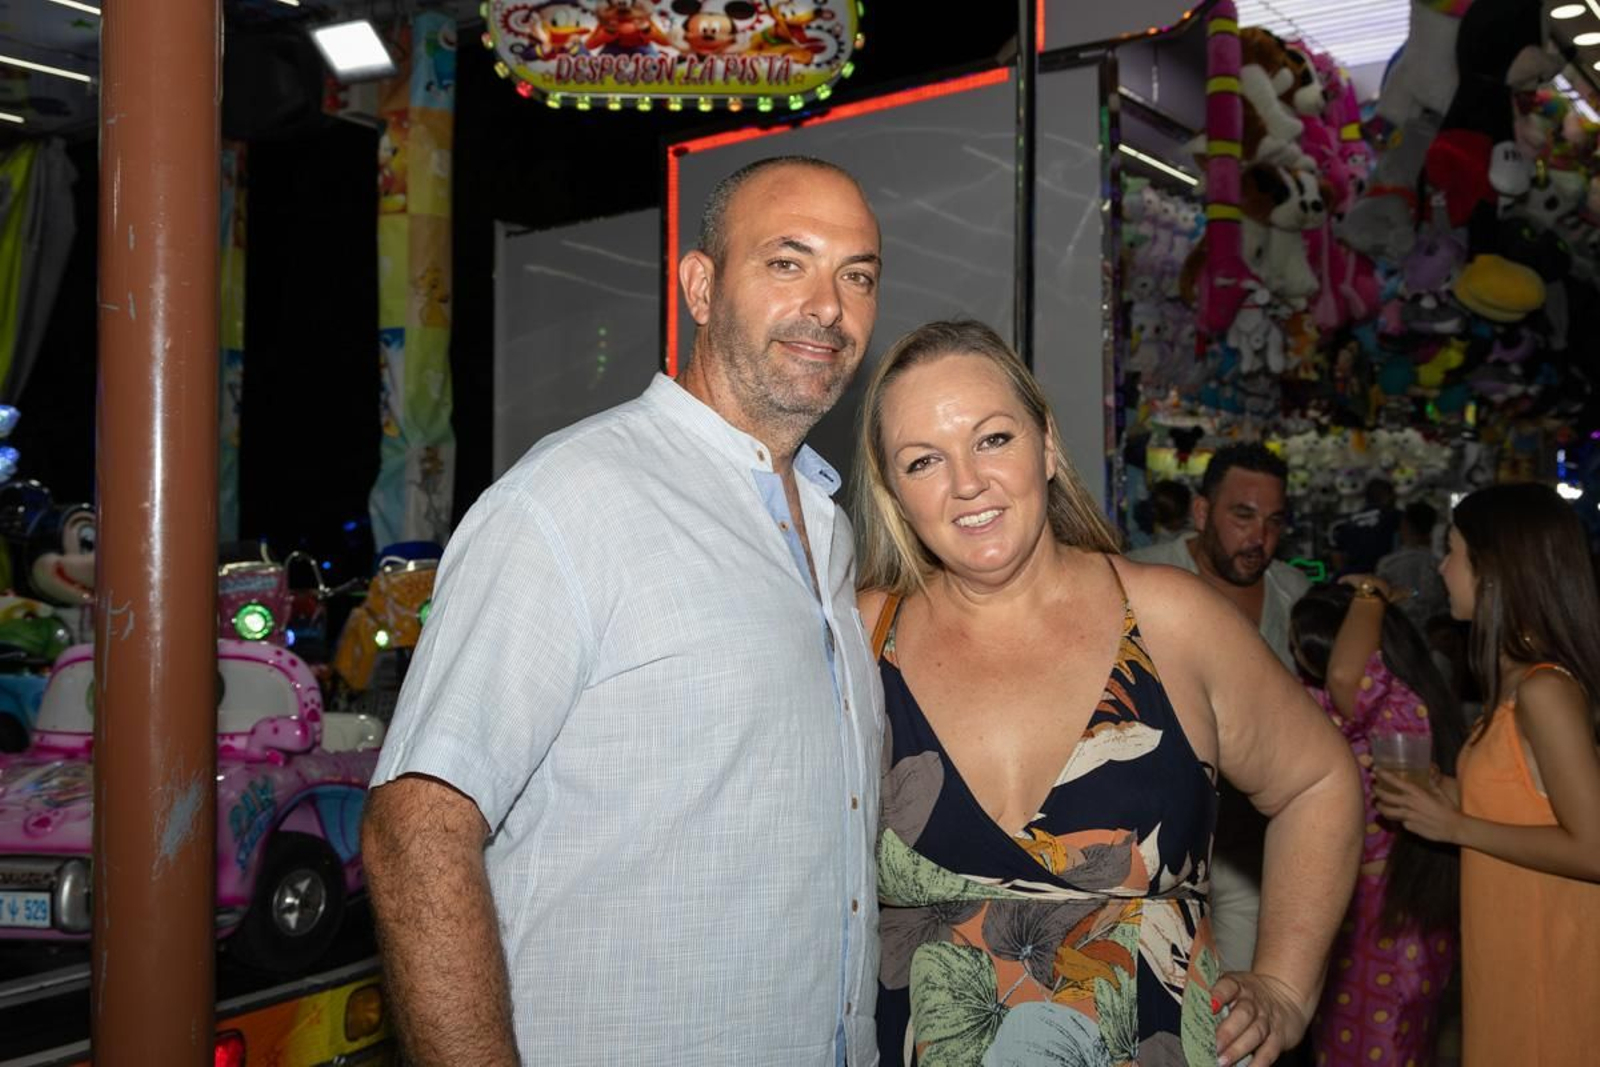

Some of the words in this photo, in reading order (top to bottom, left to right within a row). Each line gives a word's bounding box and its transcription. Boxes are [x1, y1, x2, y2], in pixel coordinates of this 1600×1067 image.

[555, 54, 676, 85] DESPEJEN
[682, 54, 715, 85] LA
[722, 54, 791, 85] PISTA
